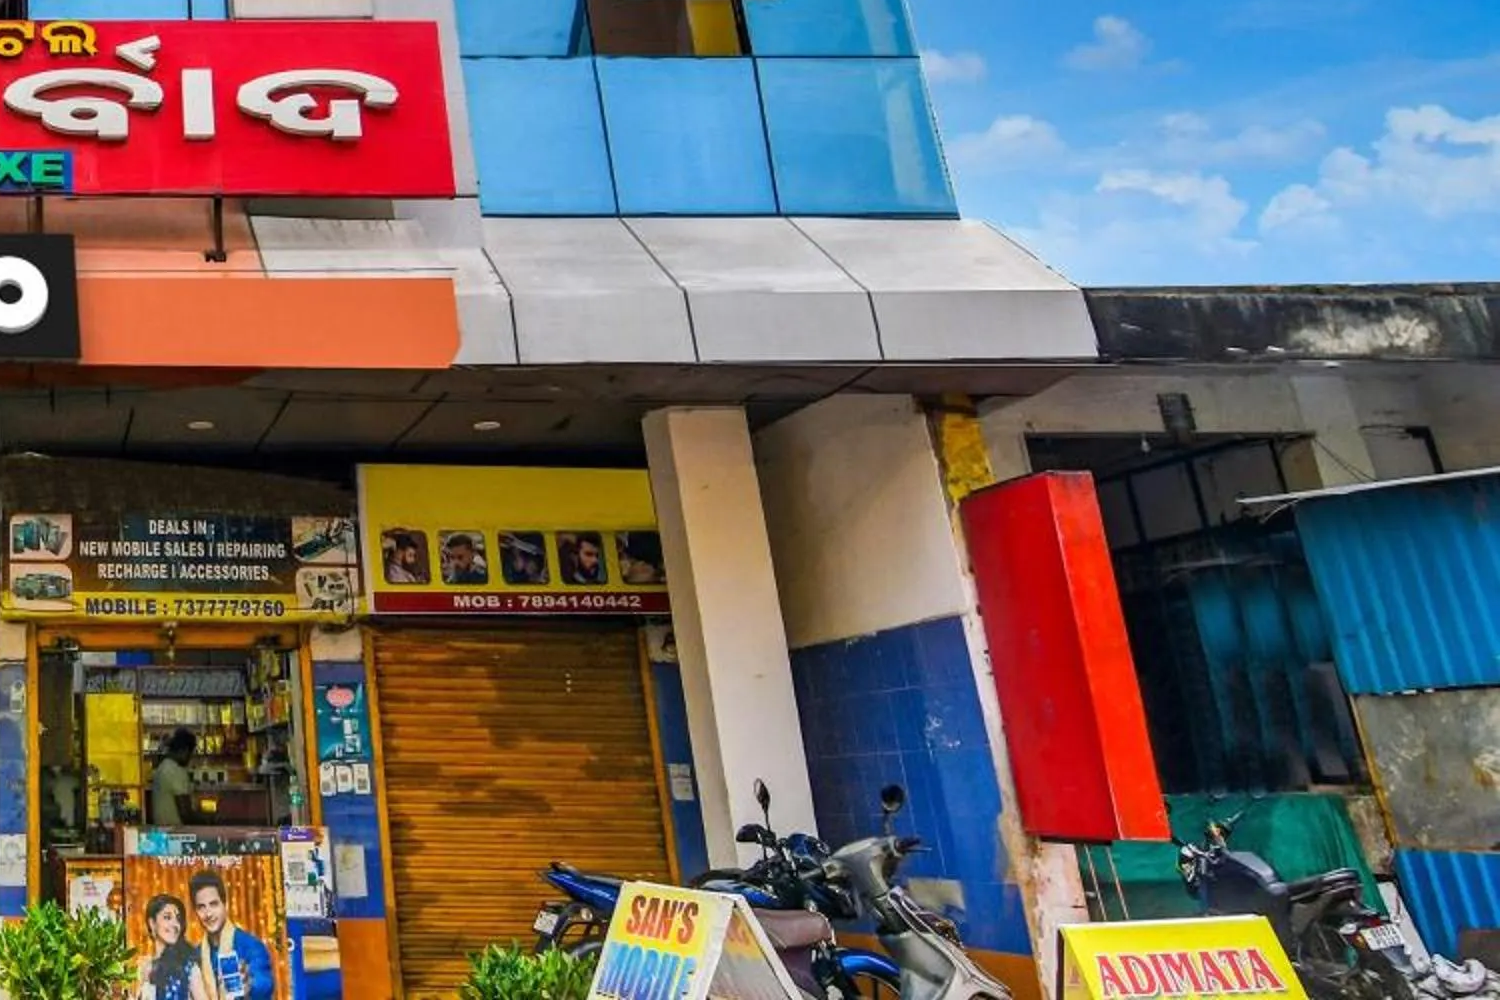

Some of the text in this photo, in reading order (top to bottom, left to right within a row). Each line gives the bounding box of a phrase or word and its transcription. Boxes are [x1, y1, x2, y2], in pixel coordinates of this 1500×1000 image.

[149, 519, 190, 535] DEALS
[79, 541, 108, 557] NEW
[111, 541, 161, 557] MOBILE
[164, 541, 205, 557] SALES
[217, 543, 286, 558] REPAIRING
[98, 563, 168, 579] RECHARGE
[180, 564, 269, 581] ACCESSORIES
[85, 598, 157, 616] MOBILE
[453, 595, 500, 608] MOB
[520, 595, 642, 609] 7894140442
[625, 894, 700, 944] SAN'S
[1096, 948, 1283, 996] ADIMATA
